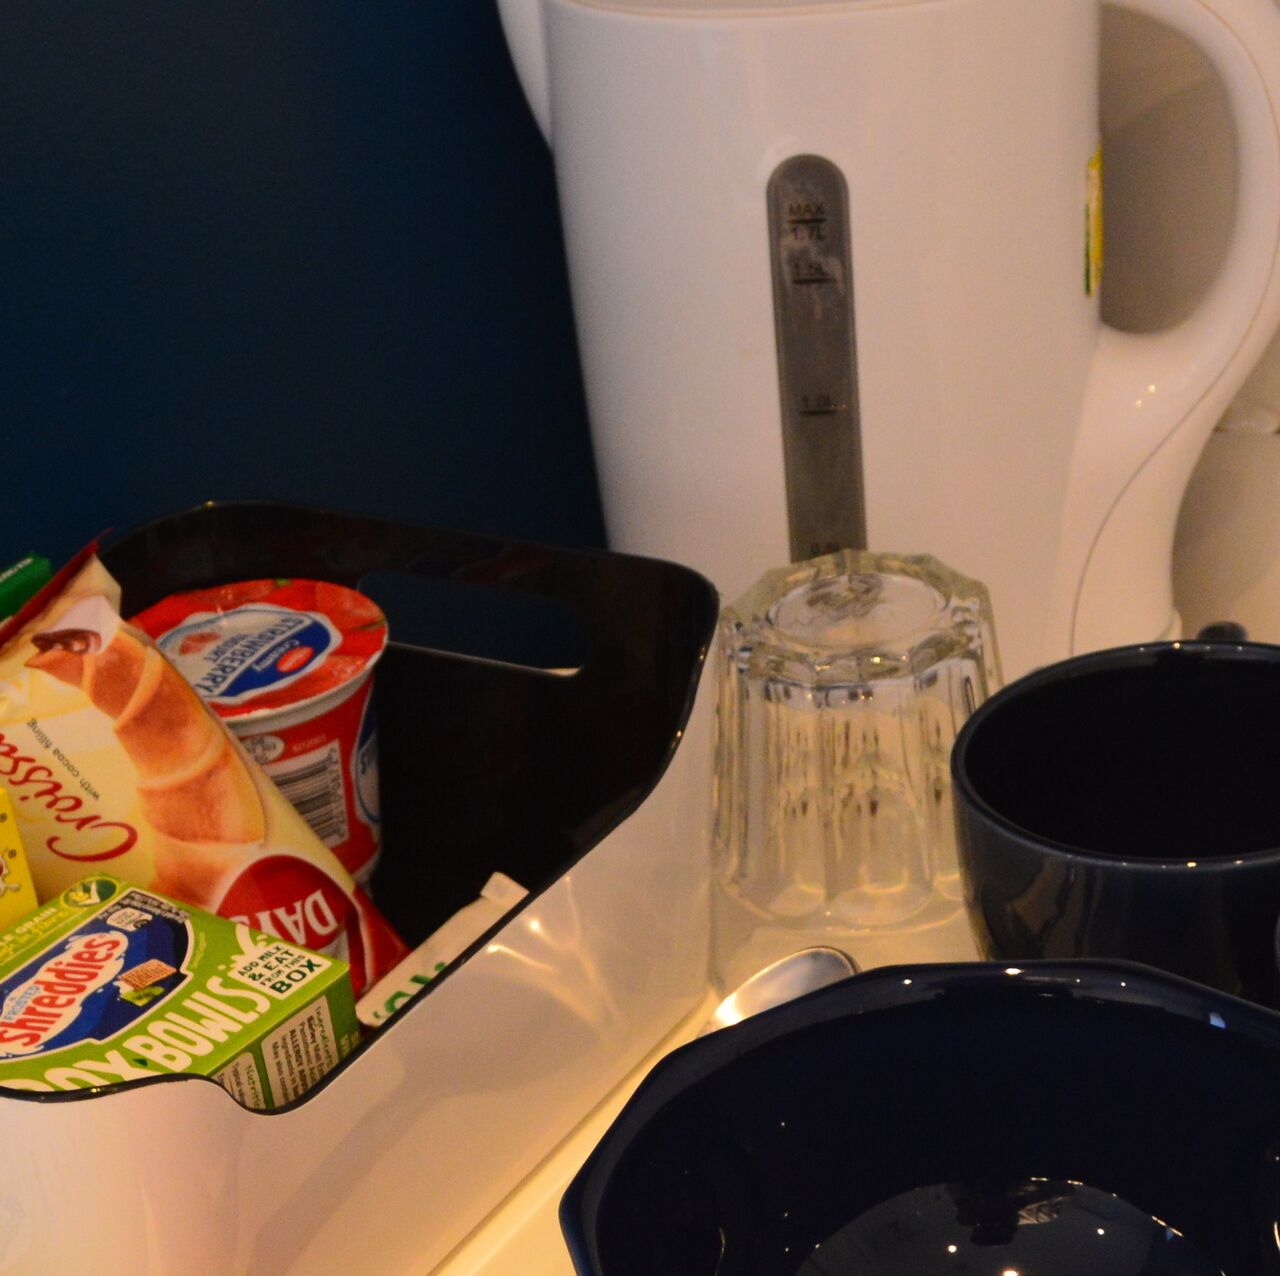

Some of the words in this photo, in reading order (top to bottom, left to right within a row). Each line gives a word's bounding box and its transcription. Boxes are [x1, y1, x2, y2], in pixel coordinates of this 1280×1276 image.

[788, 202, 826, 217] MAX
[27, 717, 53, 751] filling
[52, 747, 80, 779] cocoa
[80, 776, 100, 801] with
[237, 958, 261, 977] ADD
[259, 943, 285, 963] MILK
[248, 971, 265, 982] &
[264, 948, 295, 971] EAT
[269, 957, 322, 996] BOX
[283, 953, 307, 972] THIS
[122, 974, 271, 1073] BOWLS
[289, 1028, 304, 1067] ALLERGY
